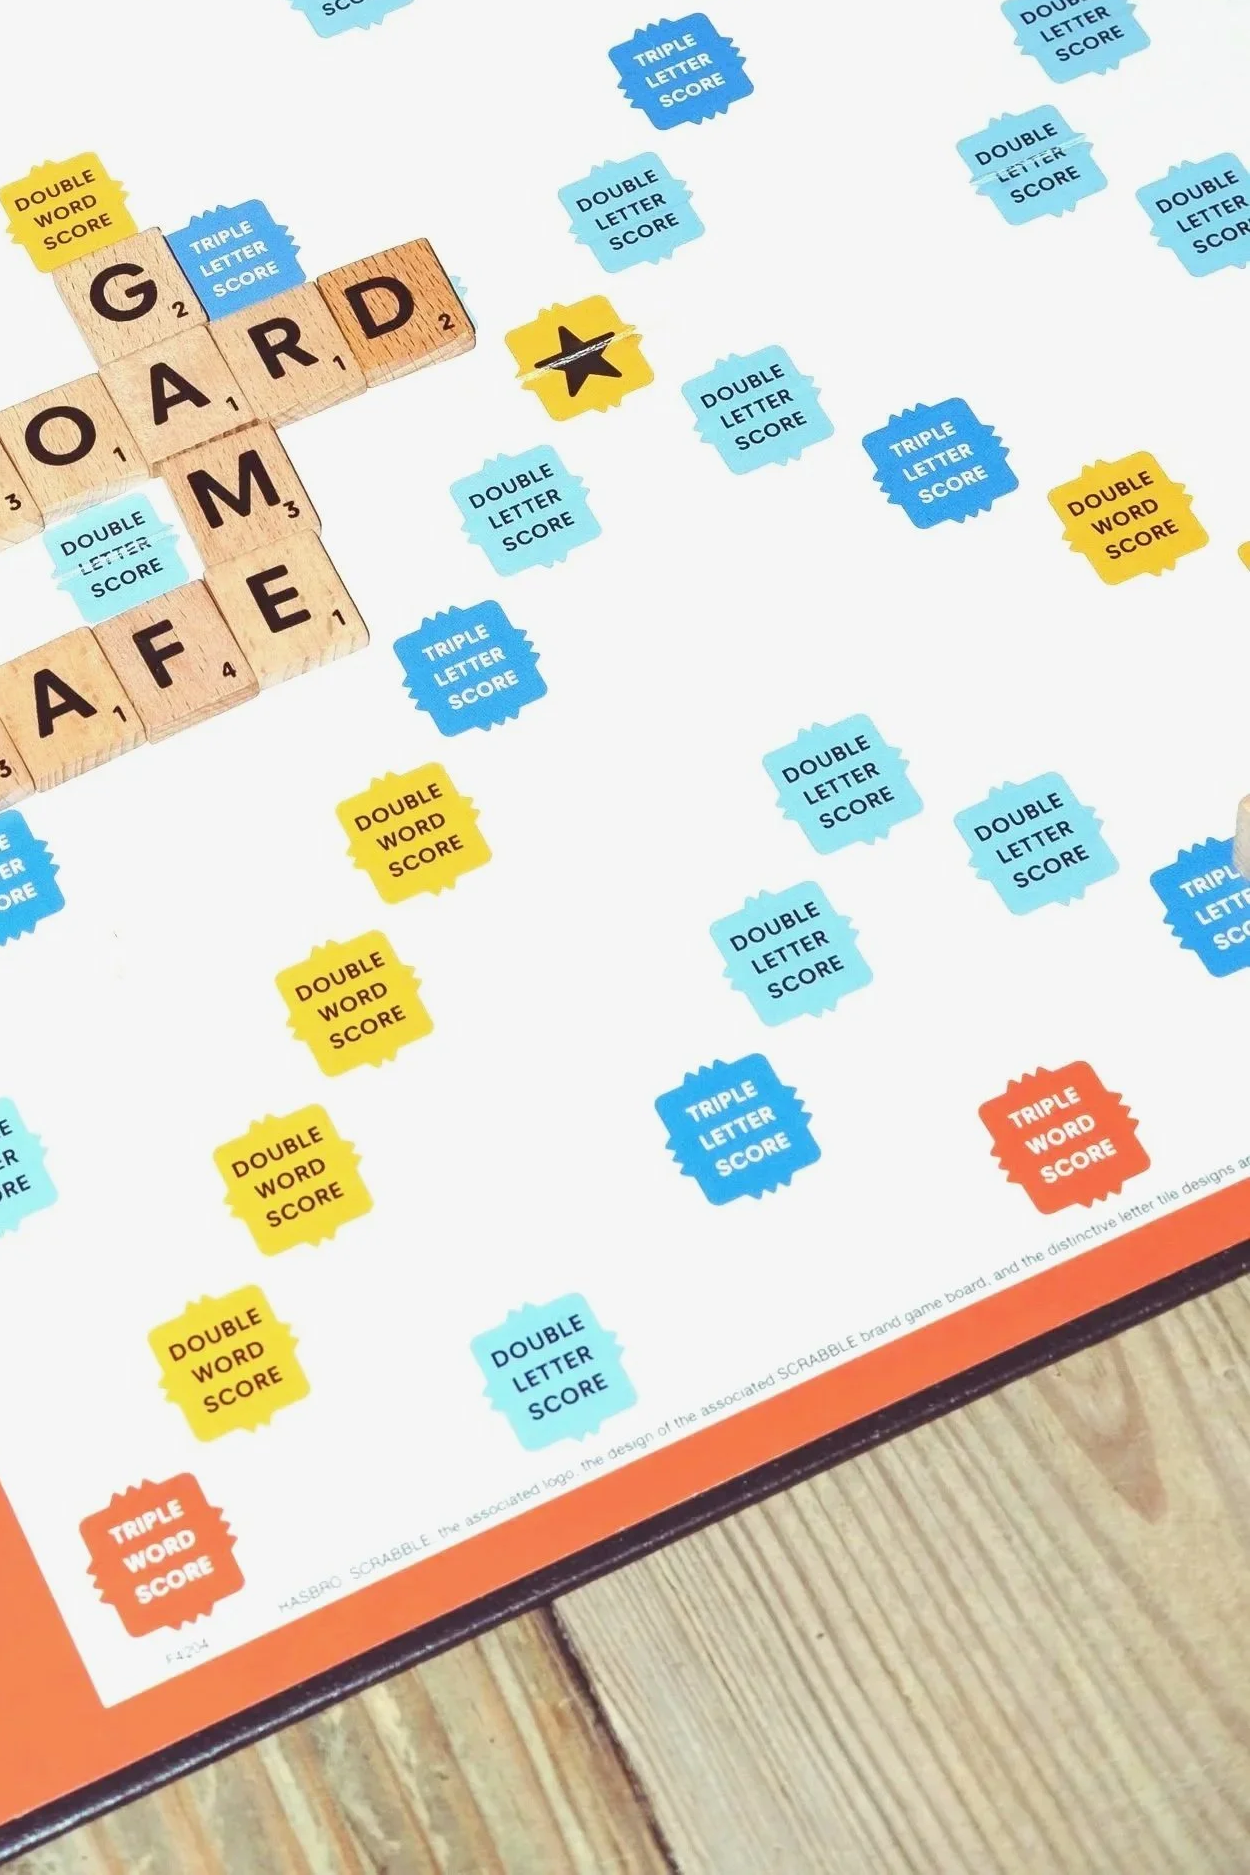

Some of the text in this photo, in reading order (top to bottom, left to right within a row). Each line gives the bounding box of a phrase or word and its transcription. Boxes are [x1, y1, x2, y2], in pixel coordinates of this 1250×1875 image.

[1039, 5, 1111, 43] LETTER
[1055, 24, 1125, 62] SCORE
[632, 32, 698, 67] TRIPLE
[644, 51, 713, 90] LETTER
[658, 71, 727, 108] SCORE
[575, 169, 659, 213] DOUBLE
[594, 193, 667, 231] LETTER
[1155, 170, 1239, 214] DOUBLE
[190, 220, 254, 252] TRIPLE
[609, 212, 680, 251] SCORE
[1176, 194, 1249, 234] LETTER
[200, 240, 267, 278] LETTER
[212, 260, 278, 298] SCORE
[888, 420, 957, 458] TRIPLE
[901, 442, 974, 483] LETTER
[917, 464, 988, 505] SCORE
[1066, 470, 1154, 517] DOUBLE
[1090, 498, 1159, 535] WORD
[1105, 518, 1180, 560] SCORE
[781, 734, 871, 784] DOUBLE
[802, 762, 881, 806] LETTER
[354, 782, 443, 832] DOUBLE
[819, 785, 895, 829] SCORE
[376, 812, 446, 851] WORD
[388, 834, 464, 878] SCORE
[1178, 864, 1244, 899] TRIPL
[729, 901, 821, 952] DOUBLE
[751, 930, 830, 975] LETTER
[767, 954, 845, 999] SCORE
[685, 1079, 759, 1123] TRIPLE
[1006, 1084, 1082, 1130] TRIPLE
[698, 1105, 777, 1152] LETTER
[1023, 1112, 1097, 1157] WORD
[714, 1131, 791, 1178] SCORE
[1038, 1136, 1118, 1185] SCORE
[673, 1412, 698, 1429] the
[776, 1334, 859, 1381] SCRABBLE
[858, 1315, 902, 1343] brand
[904, 1299, 944, 1326] game
[993, 1260, 1021, 1281] and
[1020, 1251, 1045, 1268] the
[1047, 1218, 1118, 1256] distinctive
[1117, 1200, 1155, 1223] letter
[1155, 1190, 1180, 1206] tile
[1181, 1164, 1236, 1195] designs
[168, 1307, 262, 1362] DOUBLE
[490, 1313, 585, 1368] DOUBLE
[191, 1341, 264, 1383] WORD
[512, 1345, 594, 1393] LETTER
[203, 1365, 283, 1413] SCORE
[528, 1372, 608, 1421] SCORE
[107, 1498, 185, 1546] TRIPLE
[121, 1528, 197, 1575] WORD
[132, 1554, 215, 1606] SCORE
